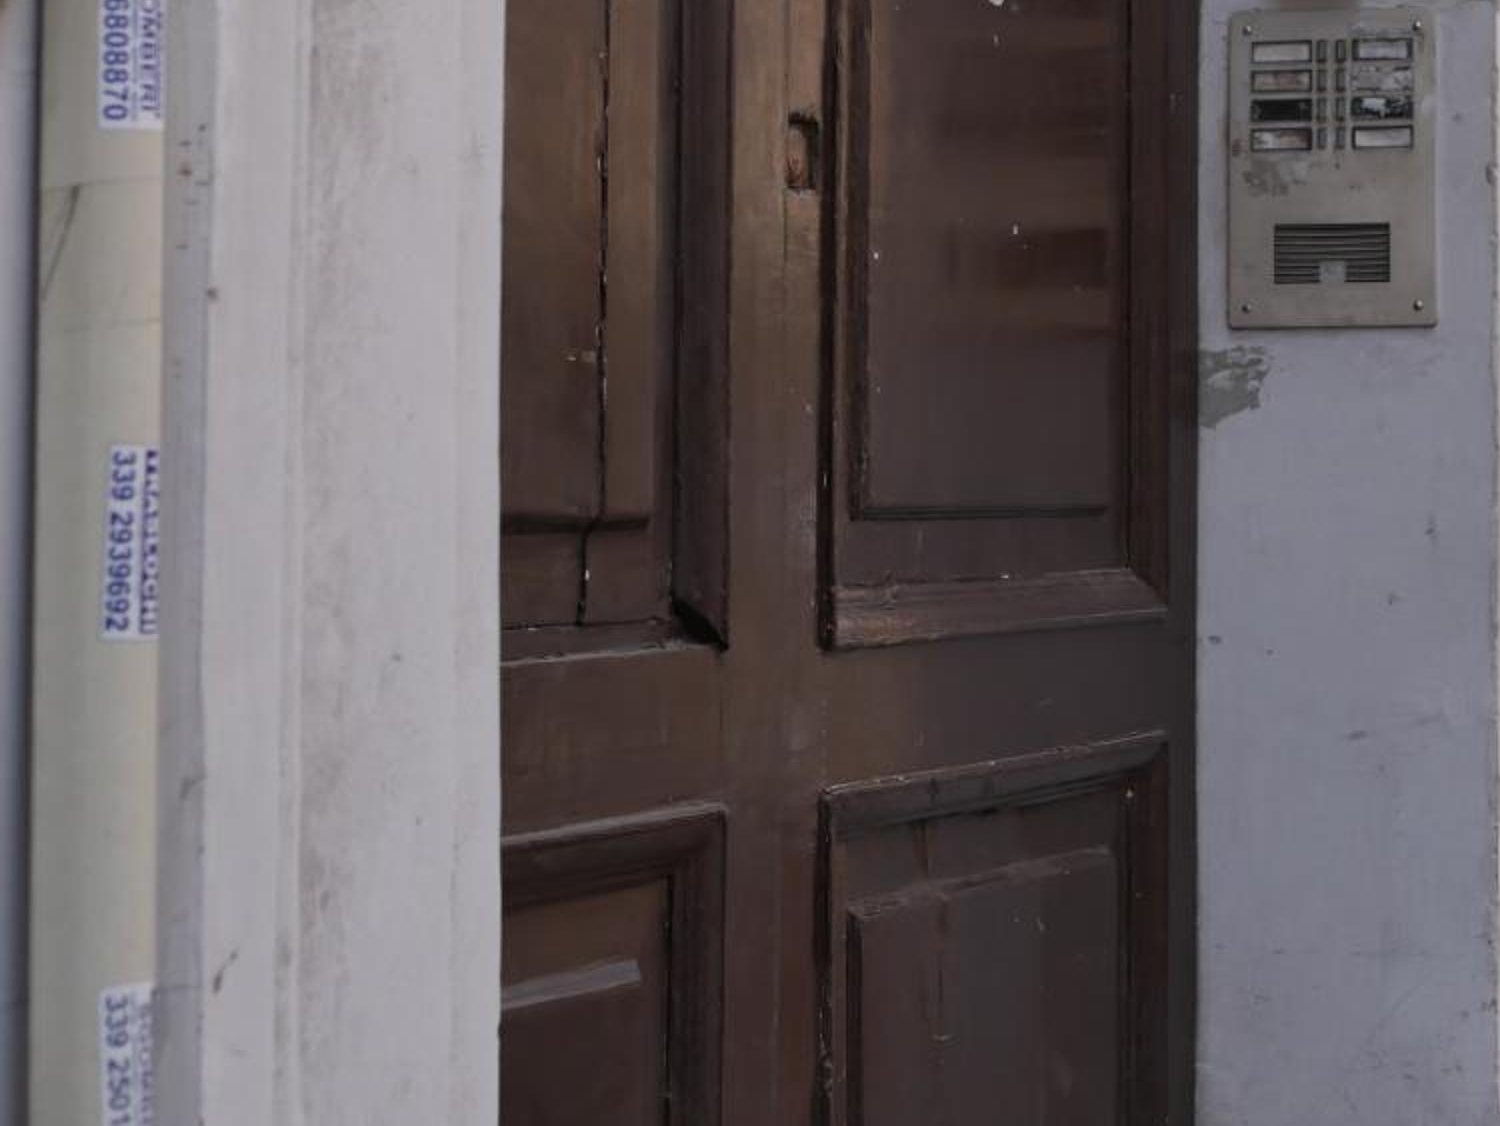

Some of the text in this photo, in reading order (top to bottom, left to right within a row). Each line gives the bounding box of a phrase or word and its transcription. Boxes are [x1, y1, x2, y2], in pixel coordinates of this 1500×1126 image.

[105, 451, 137, 632] 339 2939692
[105, 992, 129, 1049] 339
